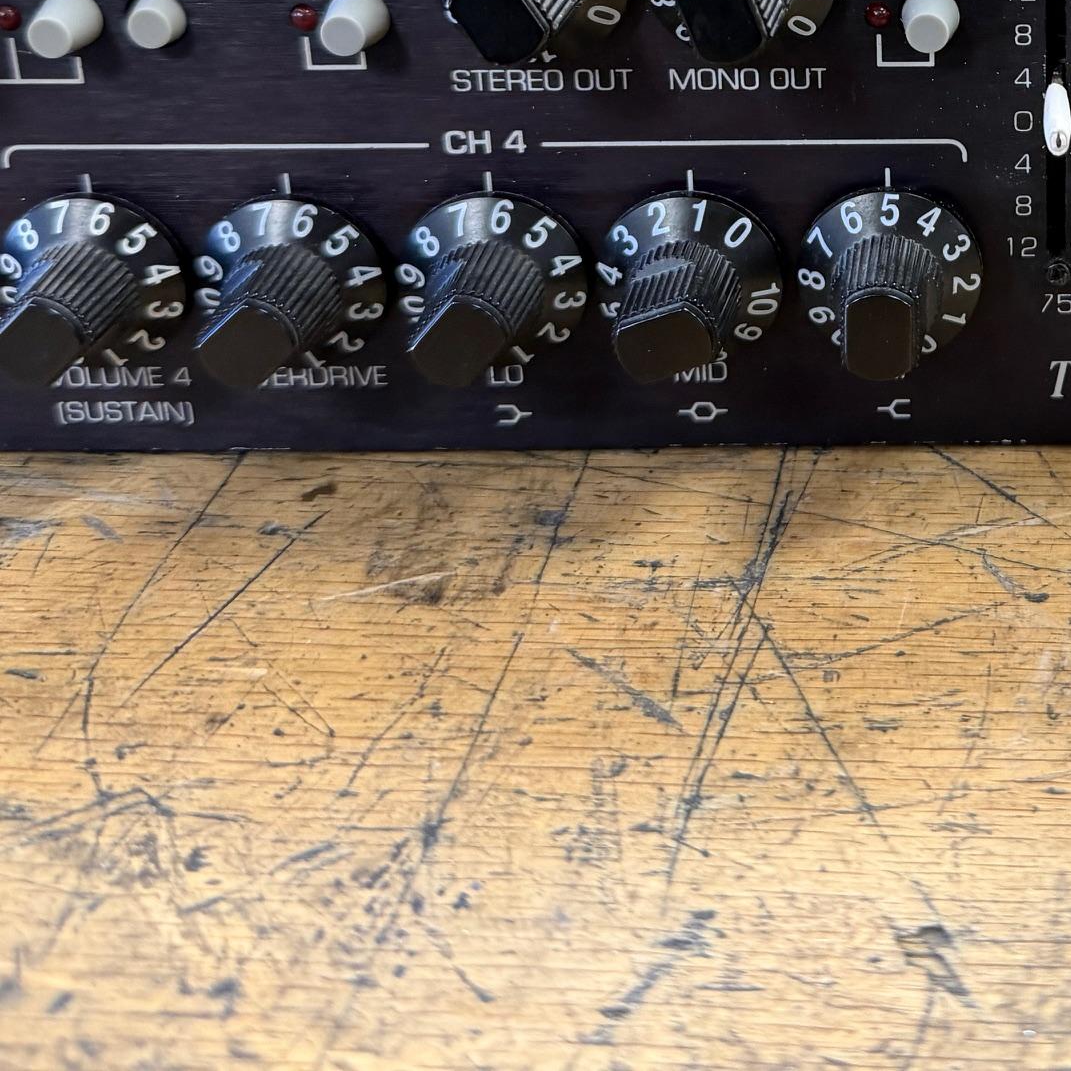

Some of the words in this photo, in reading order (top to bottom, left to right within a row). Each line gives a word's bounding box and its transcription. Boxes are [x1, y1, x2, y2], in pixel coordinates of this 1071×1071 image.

[587, 5, 621, 26] 0
[787, 15, 817, 37] 0
[1014, 24, 1032, 46] 8
[451, 68, 564, 92] STEREO
[573, 68, 633, 91] OUT
[669, 68, 760, 91] MONO
[769, 67, 827, 90] OUT
[1014, 67, 1033, 89] 4
[1013, 111, 1034, 132] 0
[443, 130, 492, 155] CH
[504, 129, 527, 153] 4
[1014, 154, 1033, 175] 4
[47, 200, 70, 234] 7
[491, 200, 514, 233] 6
[692, 200, 708, 231] 1
[879, 193, 899, 226] 5
[1014, 195, 1033, 216] 8
[89, 202, 116, 236] 6
[249, 203, 273, 236] 7
[292, 204, 318, 238] 6
[448, 202, 468, 236] 7
[648, 202, 670, 236] 2
[840, 202, 863, 234] 6
[917, 207, 941, 237] 4
[17, 218, 40, 251] 8
[117, 222, 157, 256] 5
[216, 220, 241, 253] 8
[322, 225, 360, 256] 5
[415, 226, 439, 257] 8
[524, 217, 557, 249] 5
[613, 225, 638, 256] 3
[724, 217, 752, 247] 0
[807, 227, 833, 258] 7
[943, 235, 971, 261] 3
[1006, 236, 1038, 258] 12
[144, 264, 182, 286] 4
[194, 255, 224, 281] 9
[348, 265, 382, 286] 4
[397, 263, 426, 289] 9
[551, 255, 582, 276] 4
[596, 261, 622, 286] 4
[798, 268, 825, 290] 8
[953, 273, 981, 295] 2
[148, 300, 184, 319] 3
[349, 302, 384, 320] 3
[554, 292, 586, 310] 3
[747, 283, 780, 315] 10
[808, 306, 835, 324] 9
[942, 313, 966, 325] 1
[126, 329, 167, 352] 2
[327, 331, 365, 352] 2
[537, 322, 570, 342] 2
[734, 323, 762, 341] 9
[103, 348, 129, 367] 1
[304, 350, 327, 368] 1
[511, 346, 535, 363] 1
[173, 366, 192, 386] 4
[487, 364, 524, 385] LO
[56, 401, 195, 425] (SUSTAIN)
